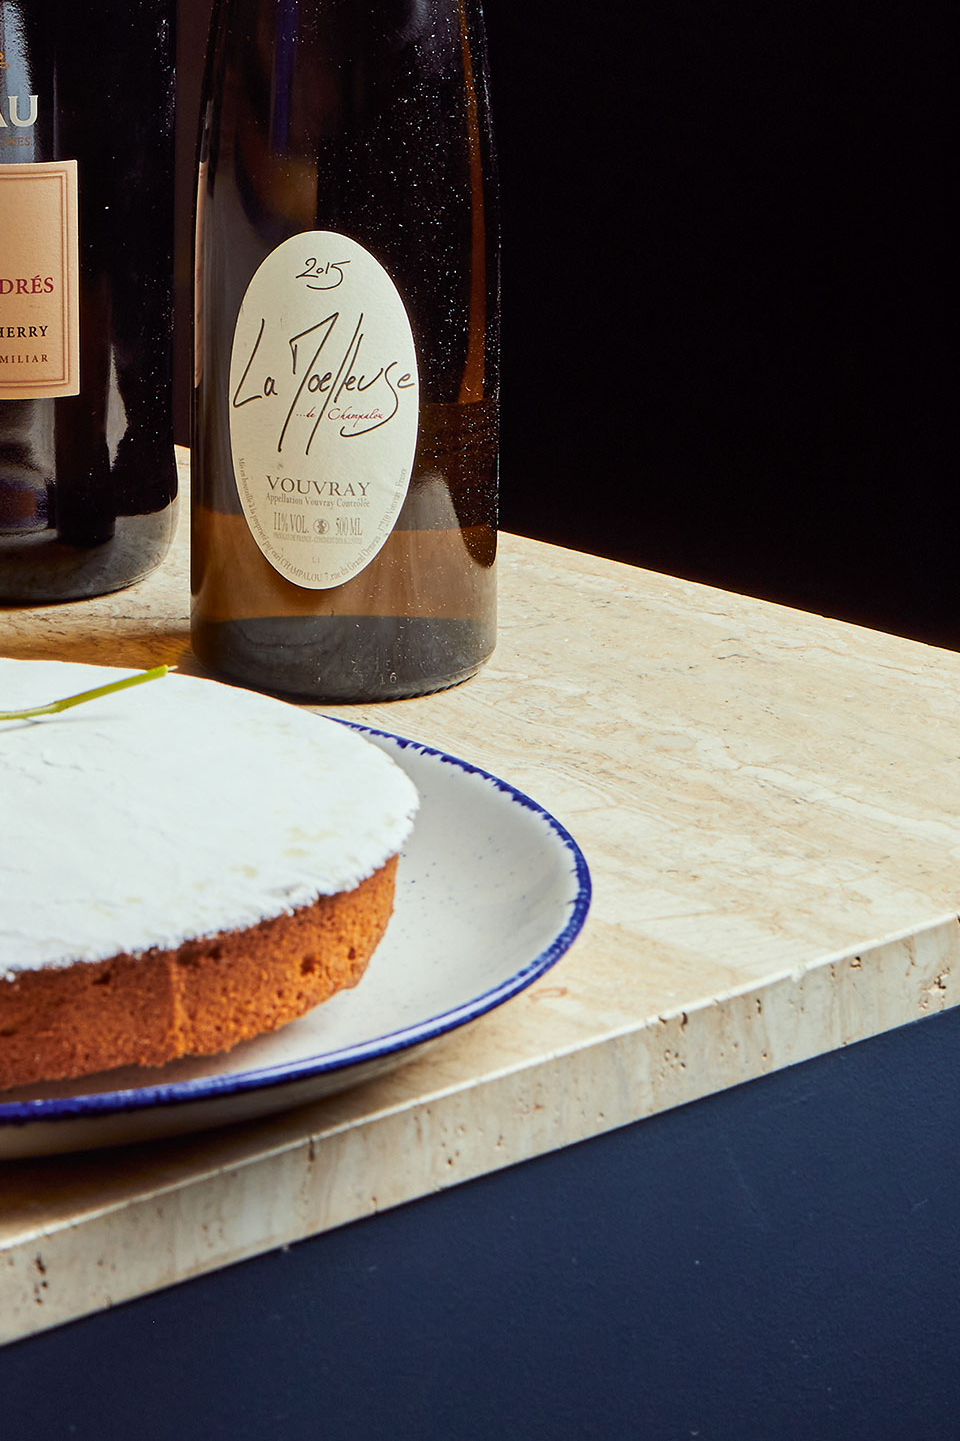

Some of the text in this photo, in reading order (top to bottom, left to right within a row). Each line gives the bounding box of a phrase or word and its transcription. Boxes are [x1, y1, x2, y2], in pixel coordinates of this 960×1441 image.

[295, 257, 351, 290] 2015
[233, 312, 415, 455] La Moelleuse
[266, 475, 371, 496] VOUVRAY
[266, 492, 303, 506] Appellation
[304, 496, 335, 509] Vouvray
